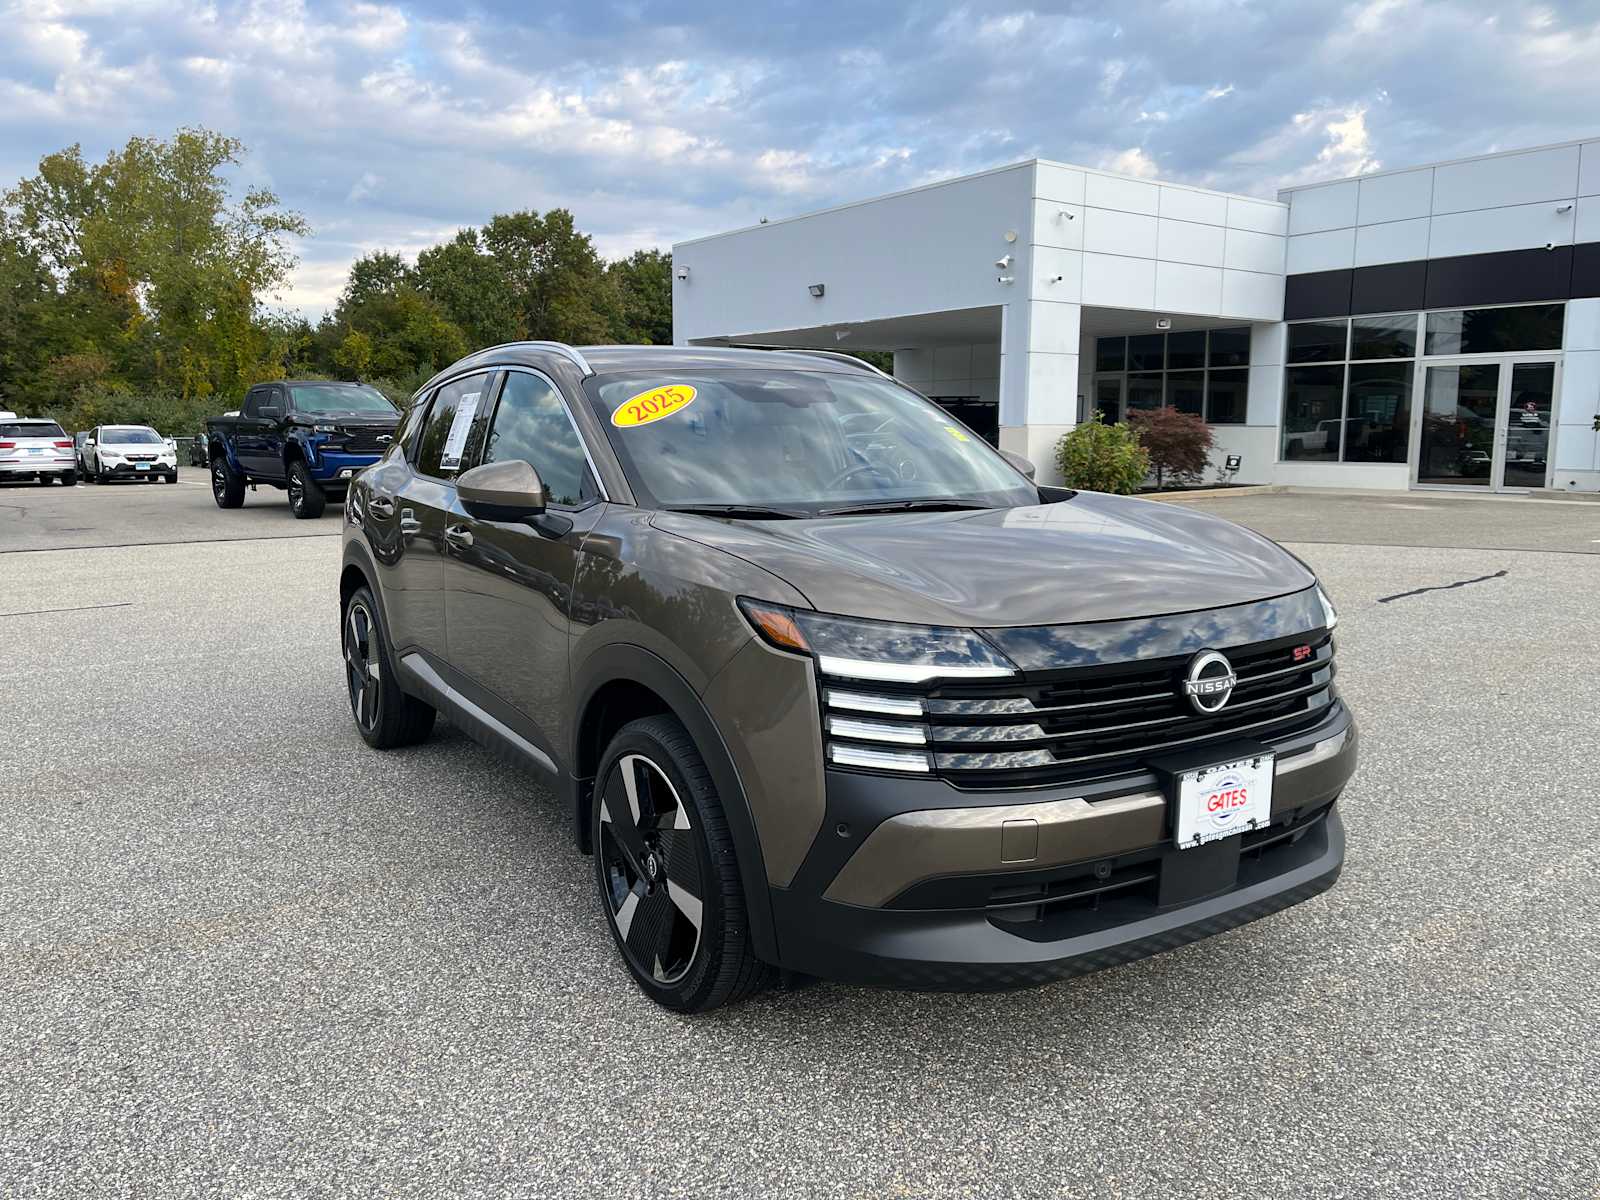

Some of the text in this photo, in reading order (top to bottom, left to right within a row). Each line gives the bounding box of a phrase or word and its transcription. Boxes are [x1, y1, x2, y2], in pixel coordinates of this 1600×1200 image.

[628, 388, 685, 422] 2025
[1293, 645, 1311, 661] SR
[1187, 677, 1237, 694] NISSAN
[1207, 787, 1247, 813] GATES
